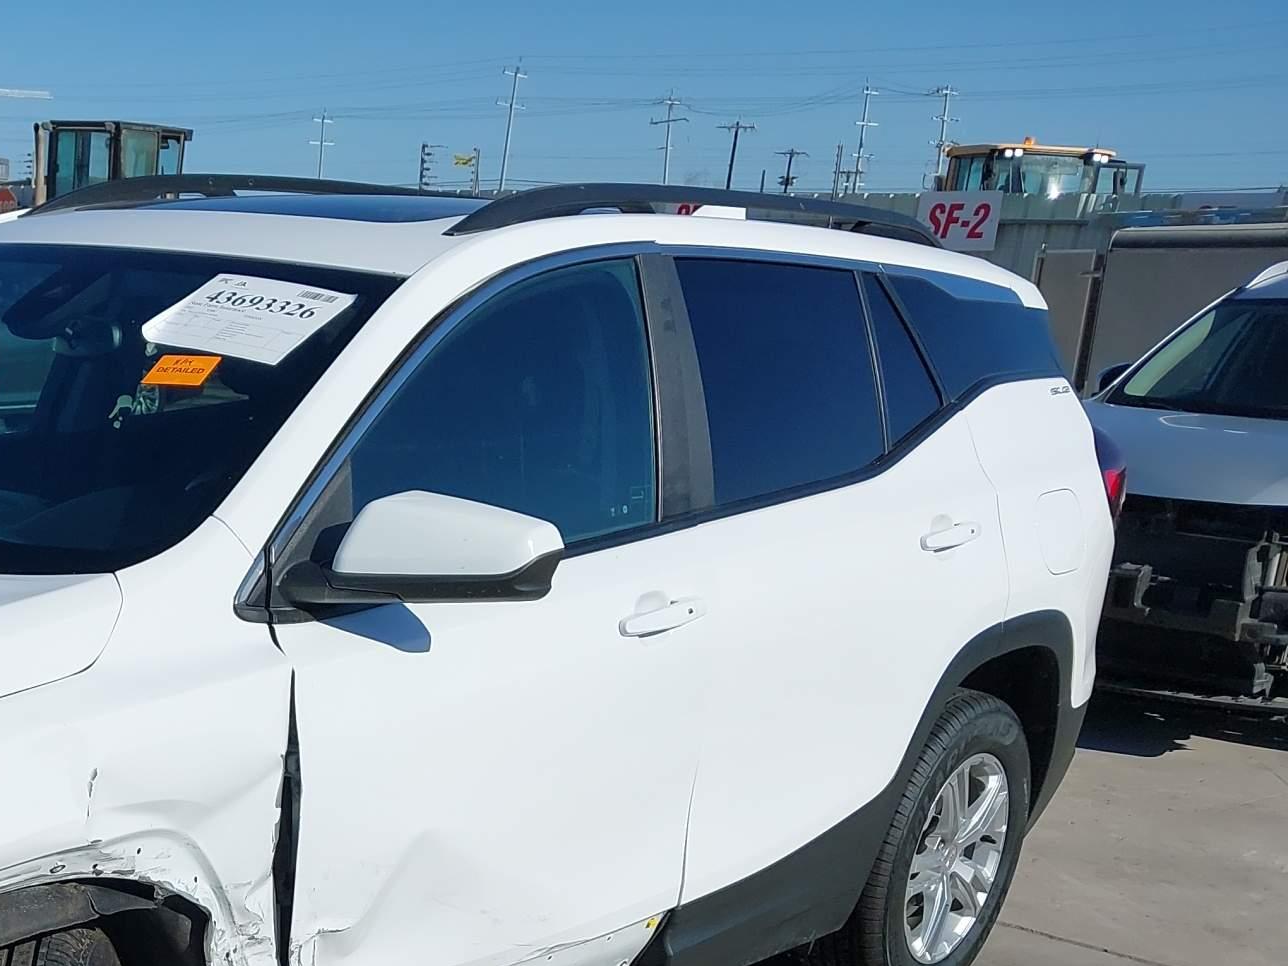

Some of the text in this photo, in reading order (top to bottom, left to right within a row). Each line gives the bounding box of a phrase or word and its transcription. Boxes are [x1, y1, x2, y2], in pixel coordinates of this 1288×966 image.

[929, 202, 991, 239] SF-2
[205, 289, 323, 319] 43693326
[156, 366, 206, 374] DETAILED
